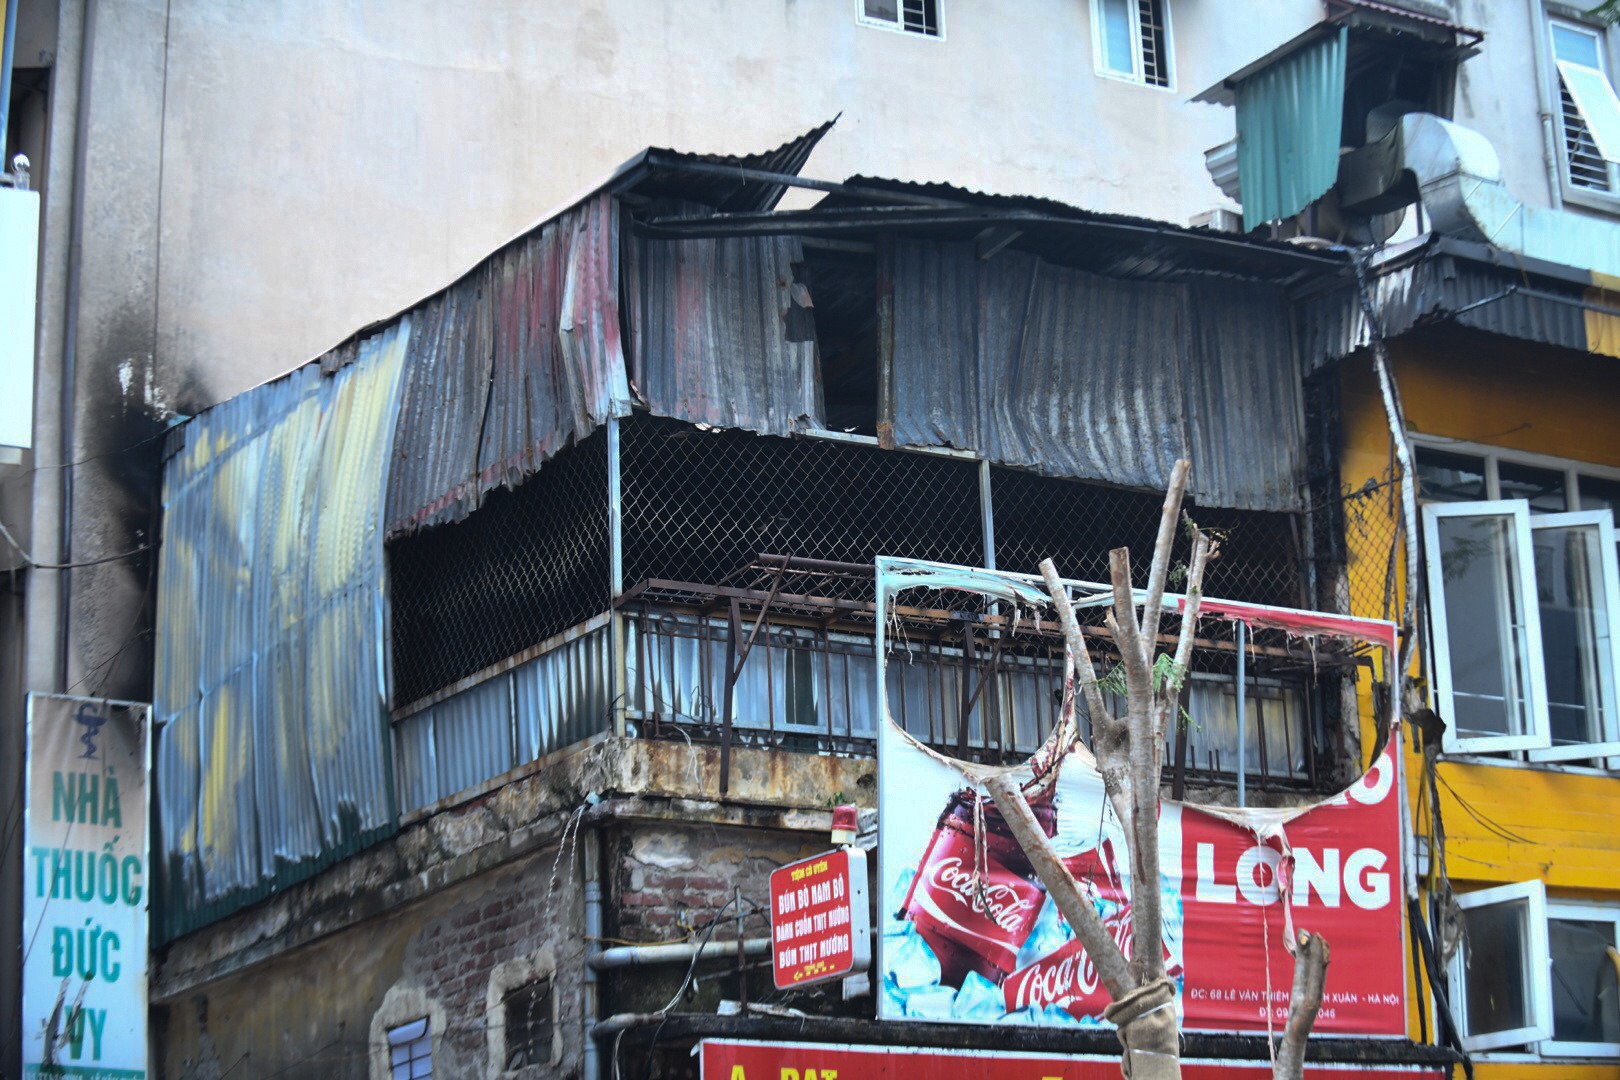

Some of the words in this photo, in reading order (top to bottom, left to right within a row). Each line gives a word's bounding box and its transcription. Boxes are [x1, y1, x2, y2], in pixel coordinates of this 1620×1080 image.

[52, 765, 123, 828] NHÀ
[32, 834, 143, 907] THUỐC
[778, 889, 796, 915] BÚN
[797, 883, 809, 910] BÒ
[811, 880, 831, 906] NAM
[833, 872, 845, 901] BỘ
[1196, 842, 1391, 910] LONG
[52, 917, 120, 983] ĐỨC
[779, 946, 797, 969] BÚN
[799, 942, 818, 965] THỊT
[820, 933, 849, 958] NƯỚNG
[813, 911, 827, 934] THỊT
[64, 1005, 107, 1061] VY
